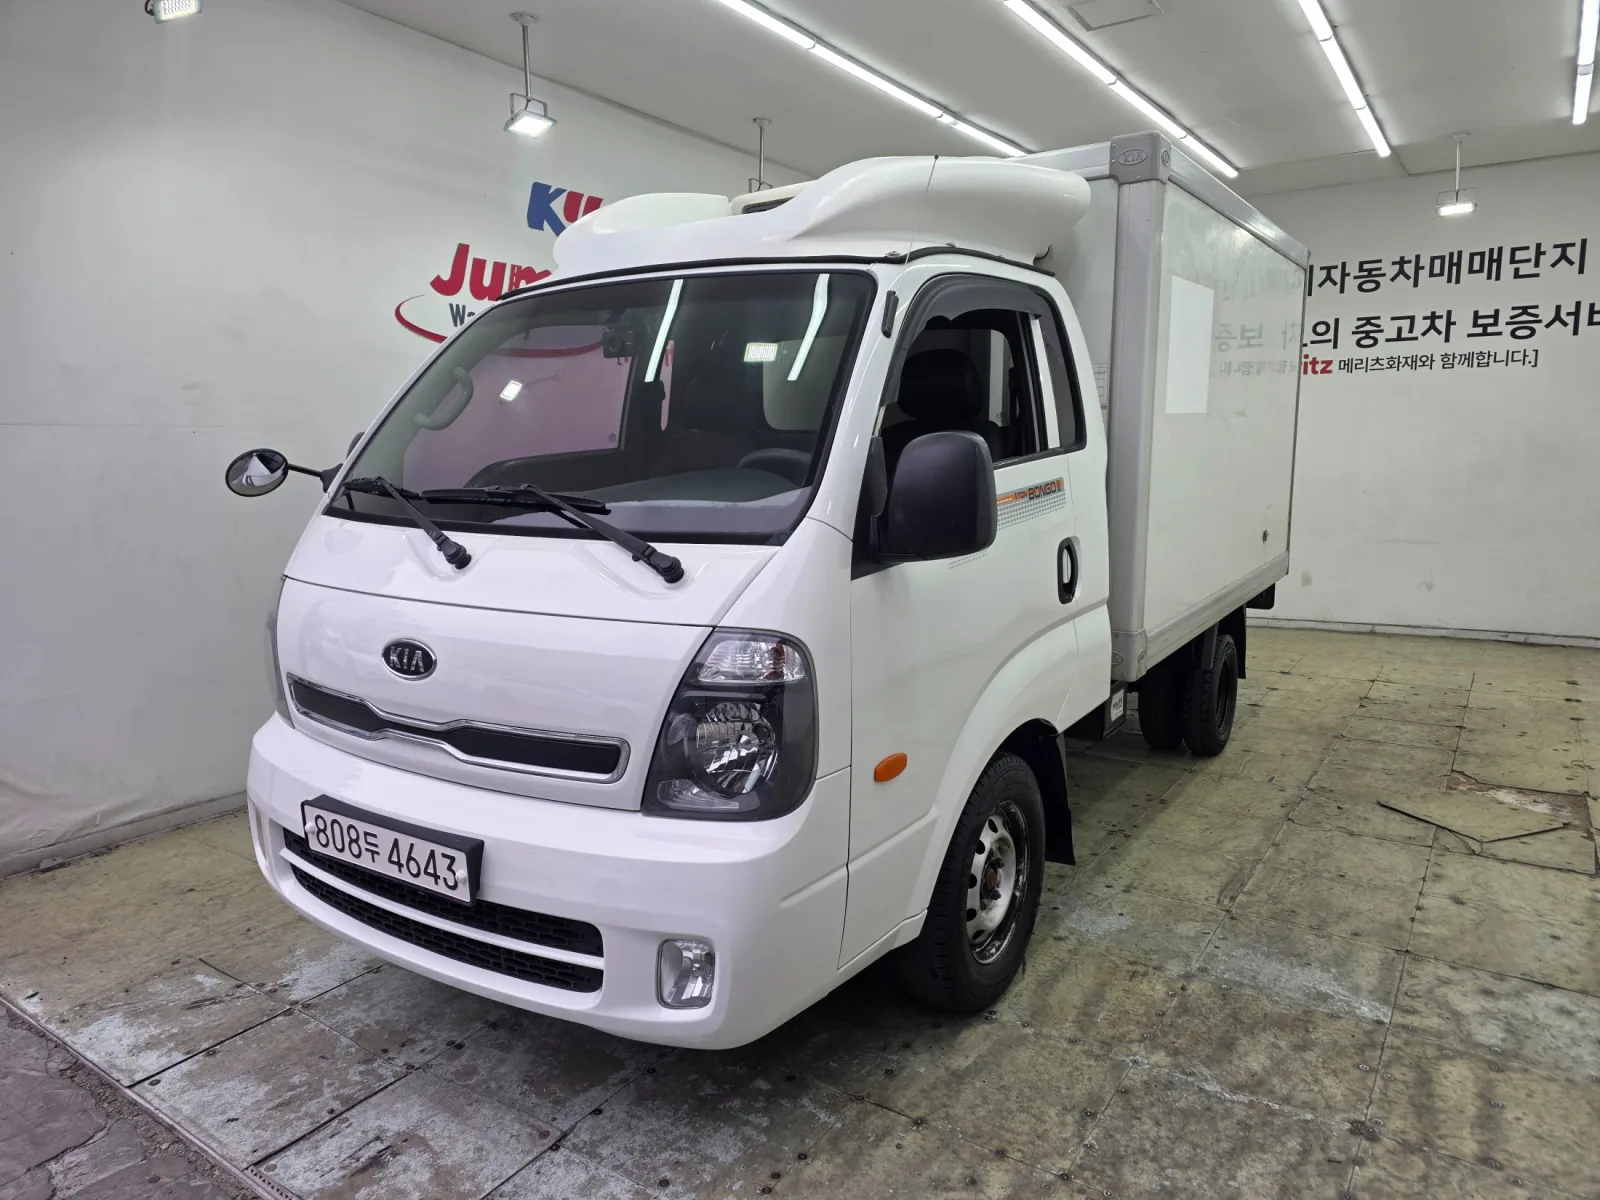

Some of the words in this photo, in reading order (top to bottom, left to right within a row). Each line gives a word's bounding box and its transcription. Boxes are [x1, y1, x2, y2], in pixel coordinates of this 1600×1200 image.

[1351, 309, 1457, 349] 중고차
[1338, 353, 1436, 374] 메리츠화재와
[1440, 348, 1539, 370] 함께합니다.]
[389, 645, 425, 673] KIA
